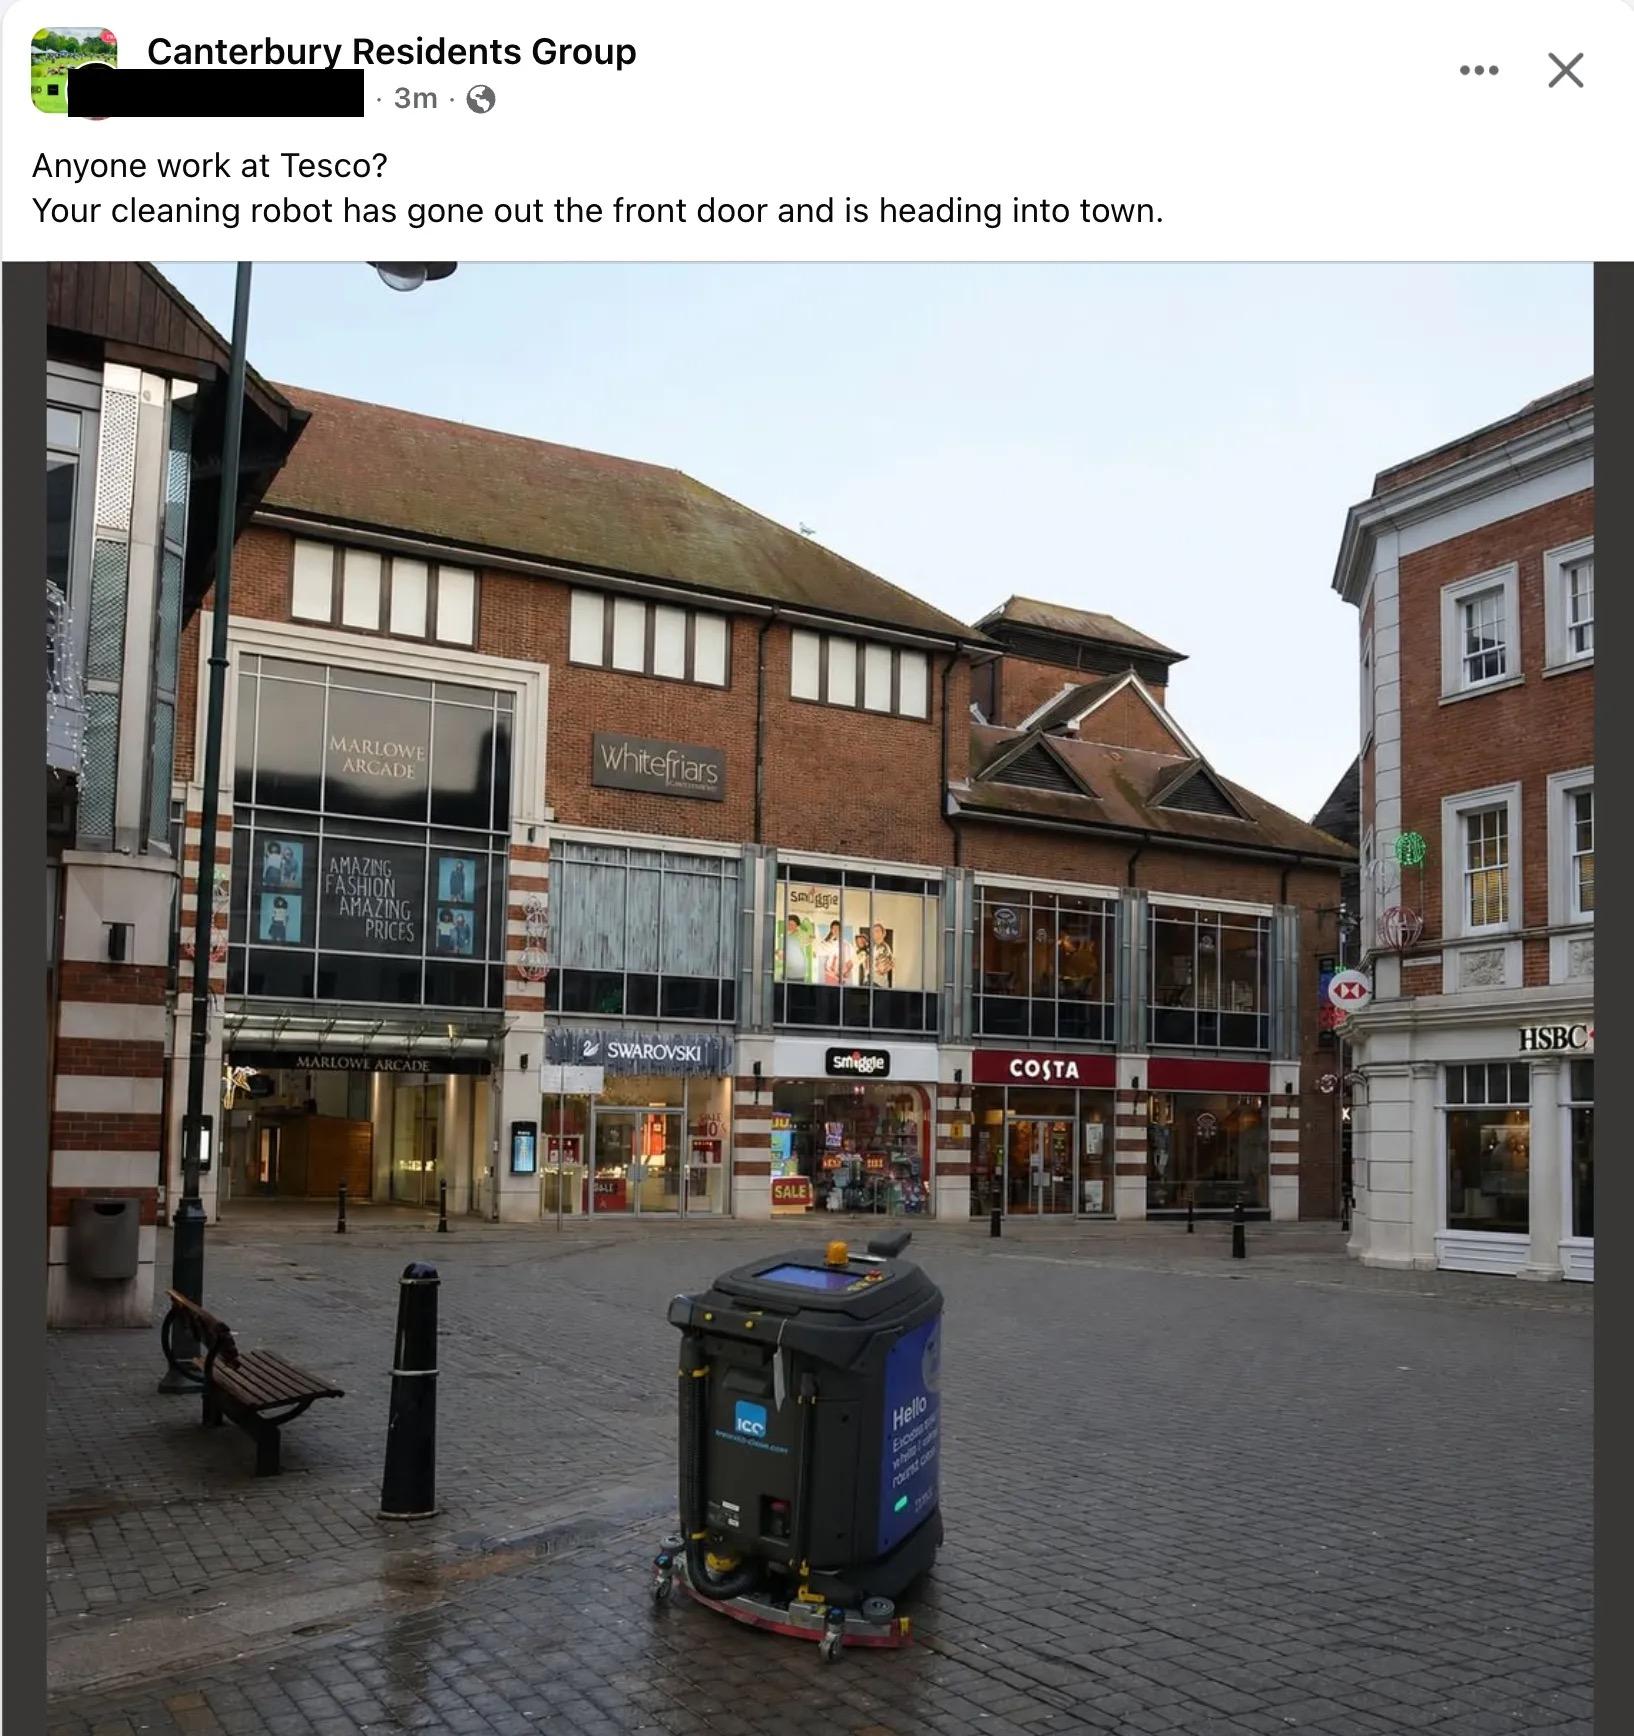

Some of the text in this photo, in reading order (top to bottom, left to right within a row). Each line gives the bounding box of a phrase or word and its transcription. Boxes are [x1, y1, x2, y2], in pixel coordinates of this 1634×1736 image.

[329, 735, 425, 762] MARLOWE
[342, 758, 416, 780] ARCADE
[600, 742, 718, 784] Whitefriars
[329, 856, 392, 878] AMAZING
[325, 873, 396, 899] FASHION
[339, 896, 412, 922] AMAZING
[365, 917, 414, 942] PRICES
[1518, 1024, 1589, 1052] HSBC
[296, 1055, 431, 1072] MARLOWE ARCADE
[607, 1041, 701, 1062] SWAROVSKI
[833, 1052, 885, 1073] smiggle
[1009, 1058, 1080, 1081] COSTA
[774, 1184, 808, 1199] SALE
[893, 1396, 927, 1431] Hello
